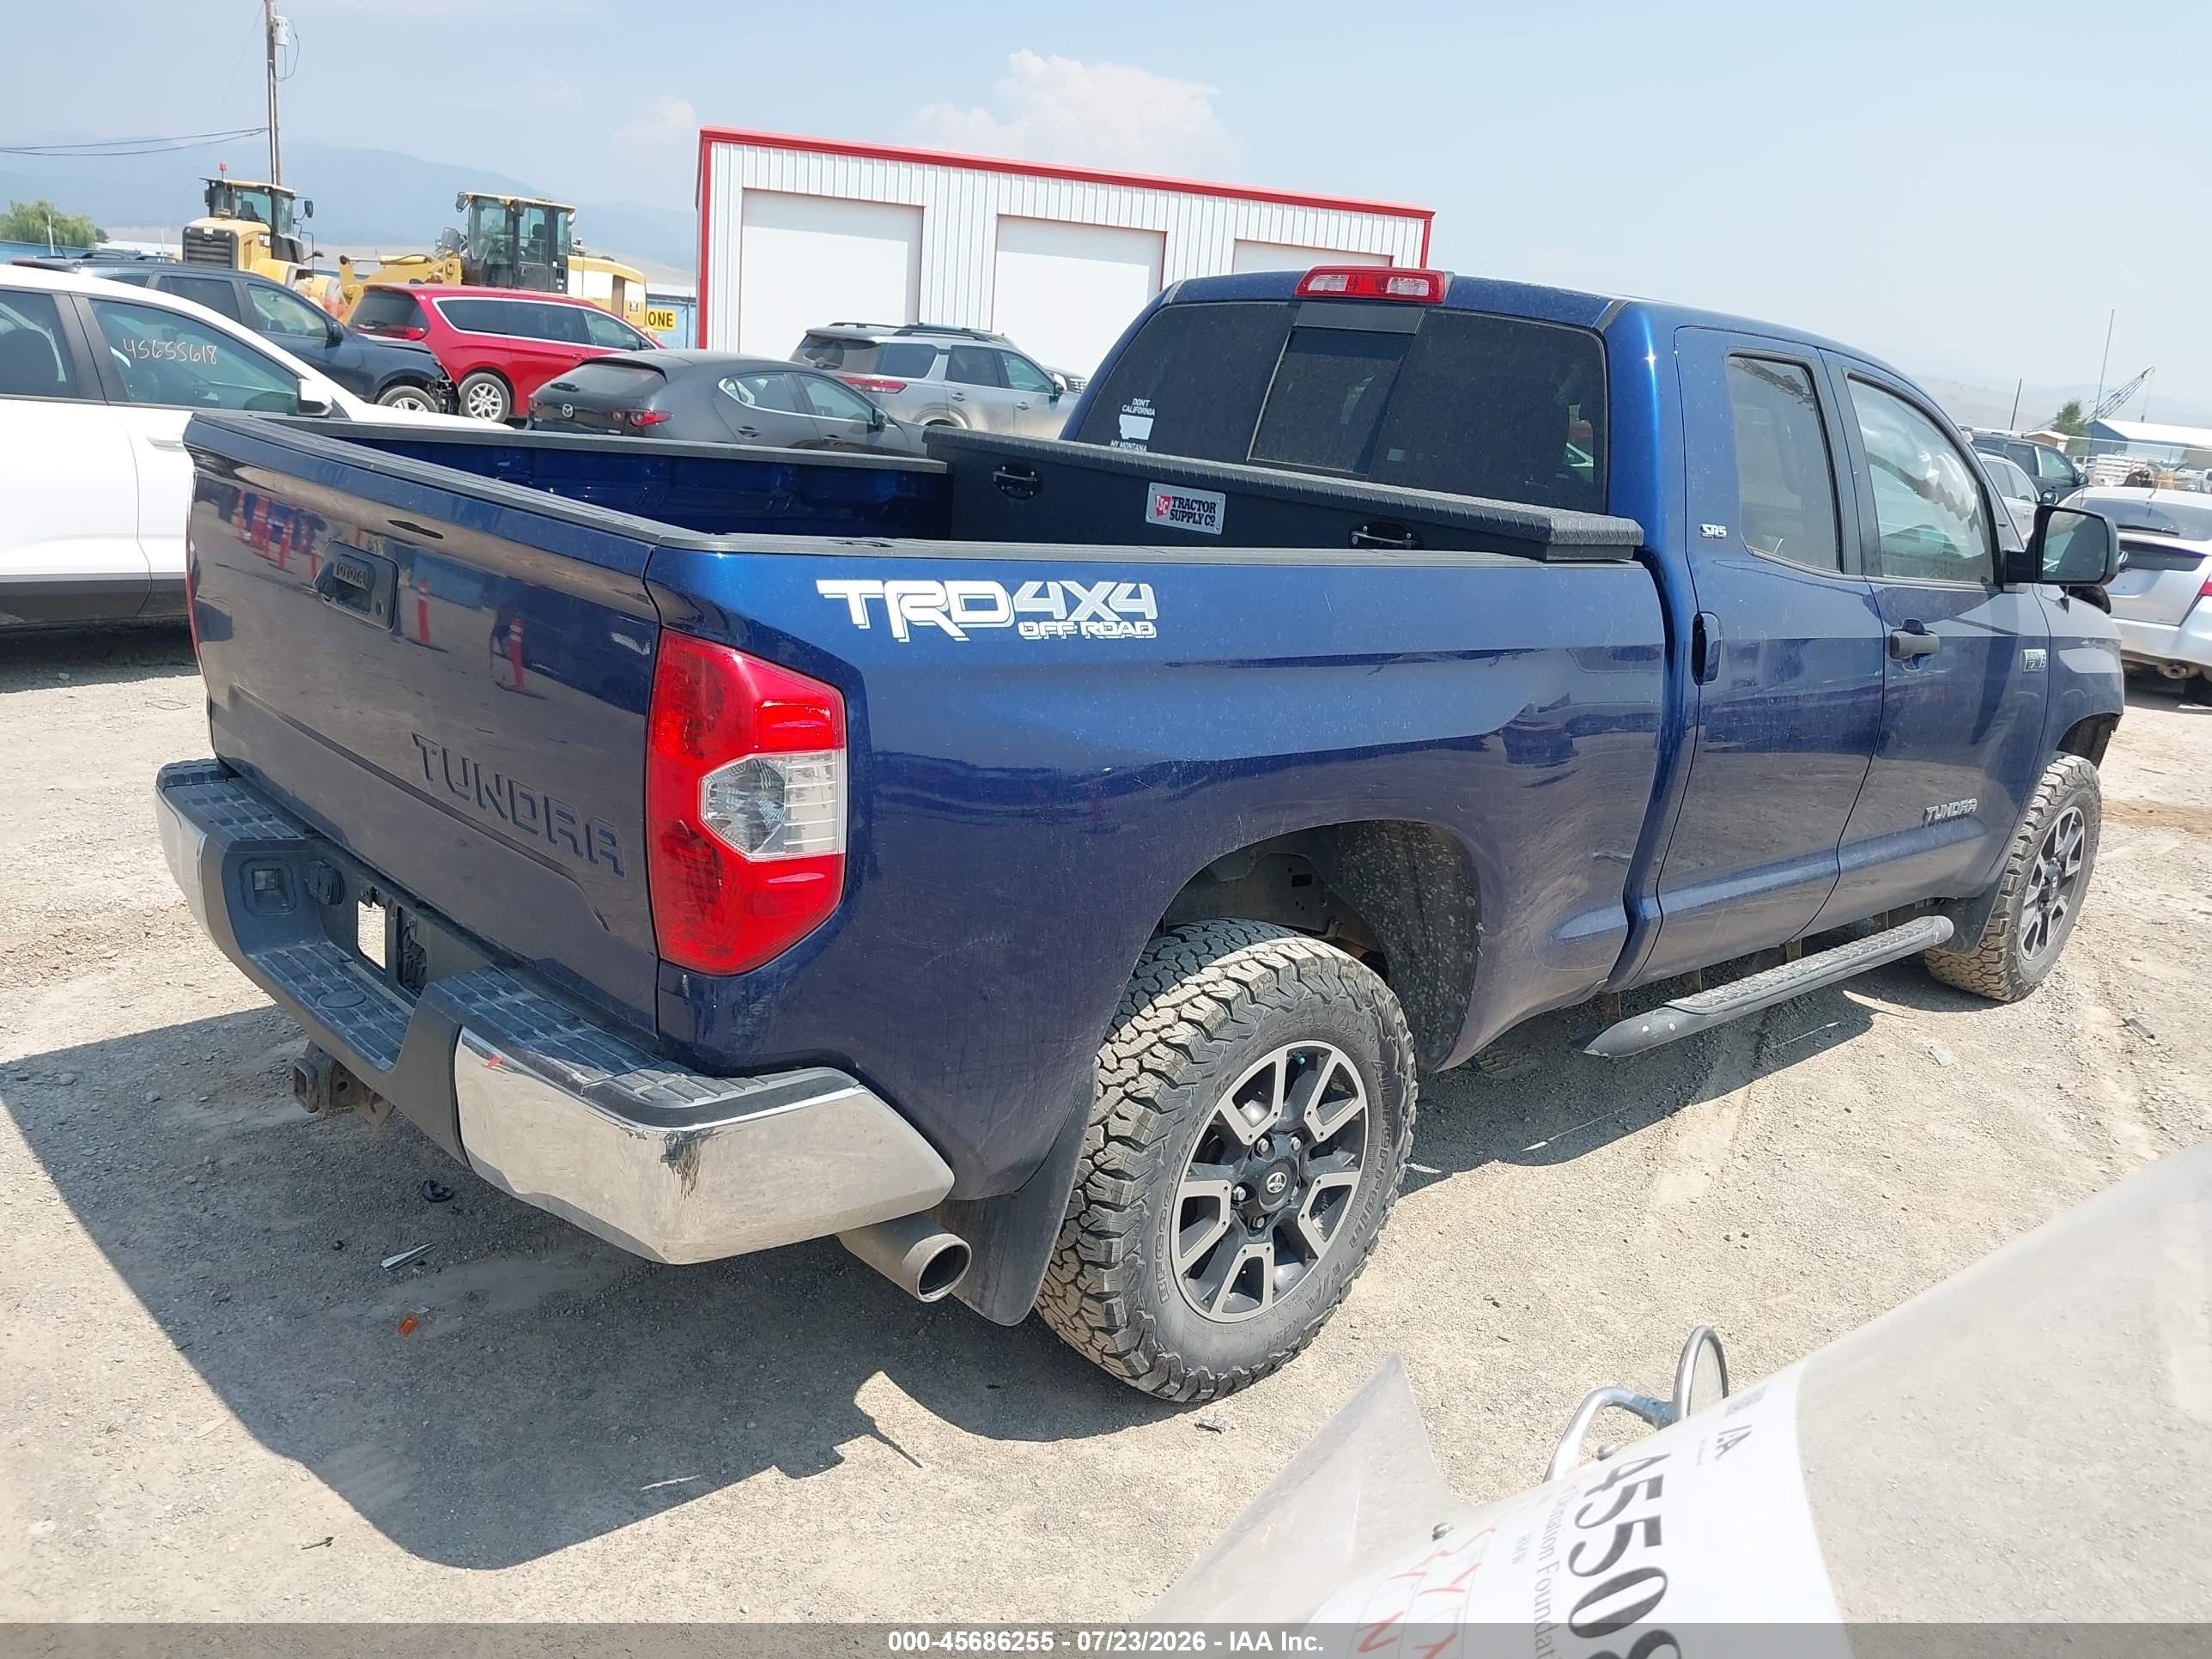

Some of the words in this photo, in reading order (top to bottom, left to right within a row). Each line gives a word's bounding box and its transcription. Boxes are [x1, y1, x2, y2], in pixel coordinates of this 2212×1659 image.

[647, 311, 674, 328] ONE
[123, 338, 217, 365] 45655618
[1121, 404, 1156, 416] CALIFORNIA
[1120, 441, 1148, 453] MONTANA
[1155, 495, 1169, 514] TSC
[1171, 496, 1217, 514] TRACTOR
[1170, 509, 1202, 526] SUPPLY
[1700, 523, 1727, 538] SR5
[335, 562, 368, 586] TOYOTA
[816, 579, 1015, 643] TRD
[411, 732, 626, 878] TUNDRA
[1925, 798, 1978, 823] TUNDRA
[1534, 1559, 1562, 1659] Foundat
